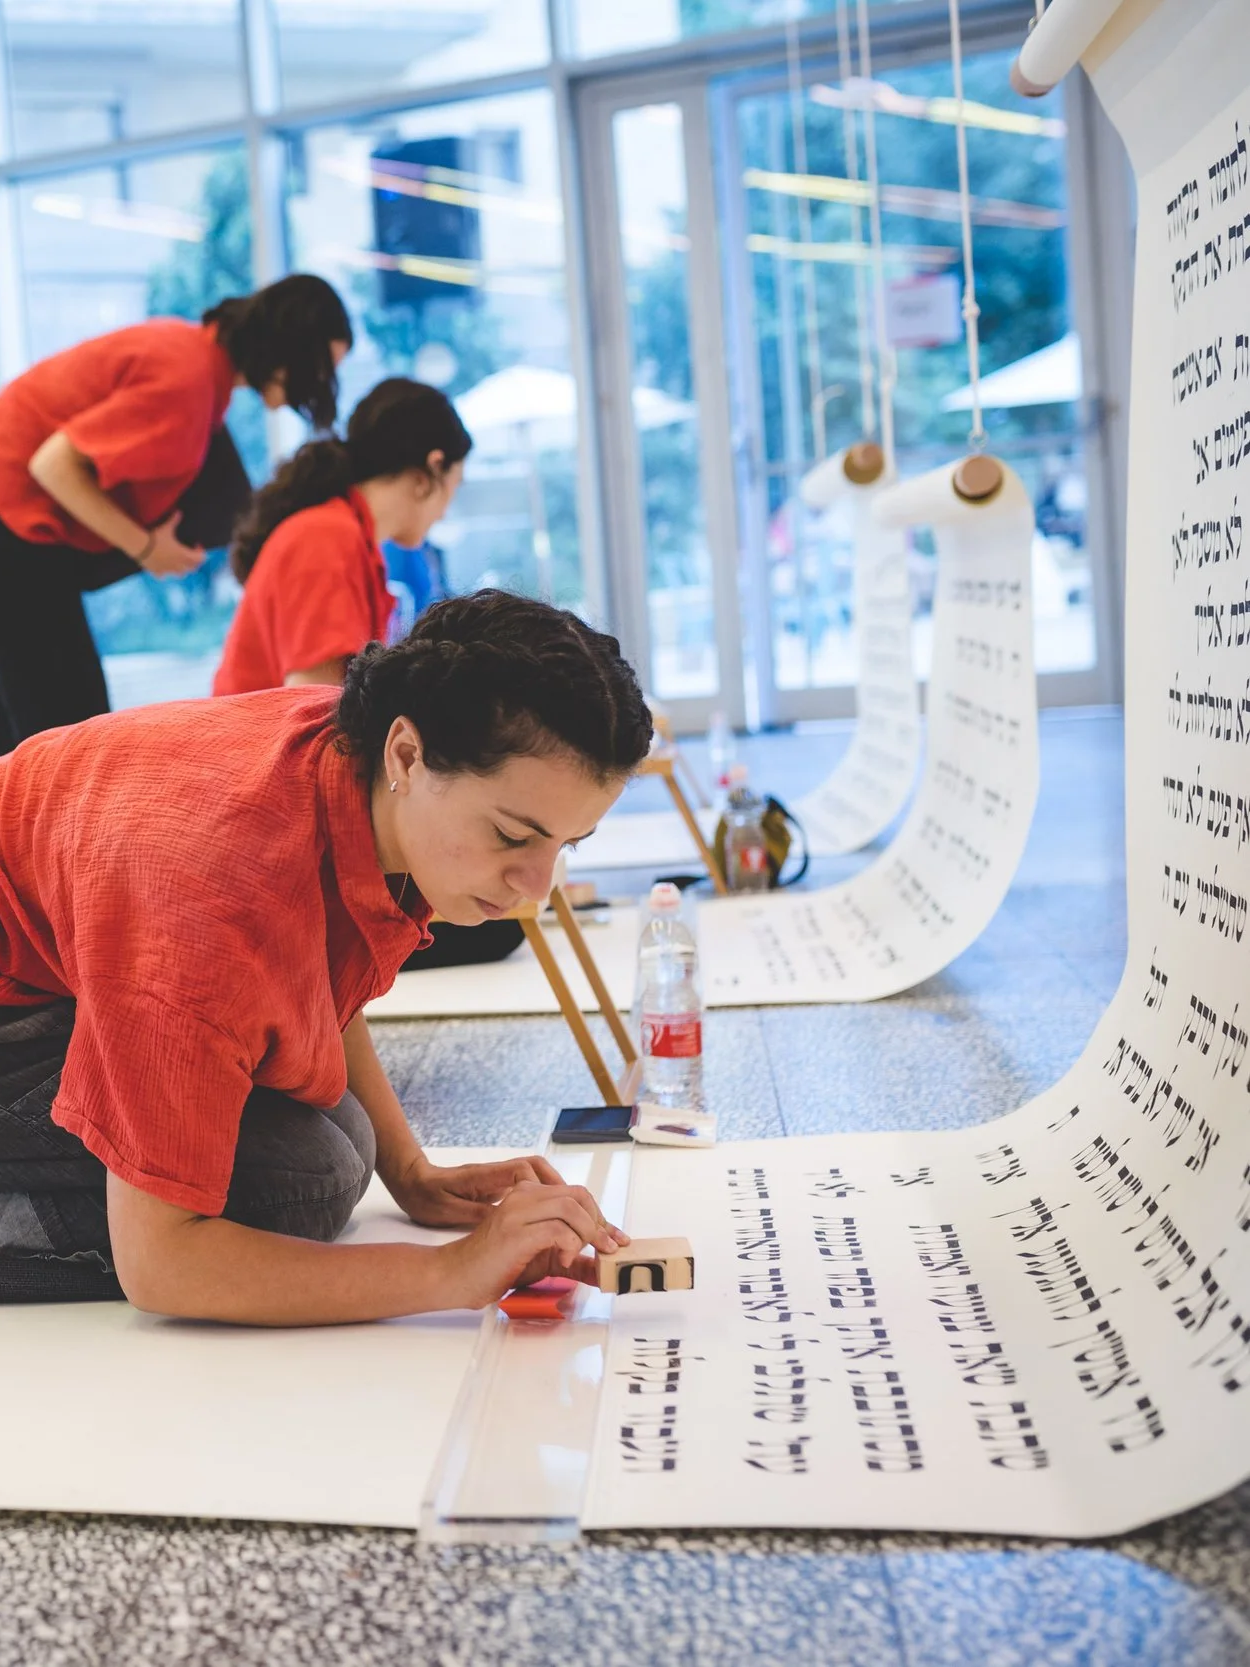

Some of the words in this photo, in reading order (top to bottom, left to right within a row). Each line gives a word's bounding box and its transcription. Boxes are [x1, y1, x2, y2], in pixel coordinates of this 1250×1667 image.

[1192, 521, 1221, 568] משנה
[1225, 495, 1242, 561] לא
[1186, 764, 1203, 826] לא
[1207, 789, 1231, 839] פעם
[1173, 870, 1189, 917] עם
[1142, 1065, 1178, 1121] לא
[1185, 1118, 1220, 1173] אני
[948, 1342, 1017, 1385] שאת
